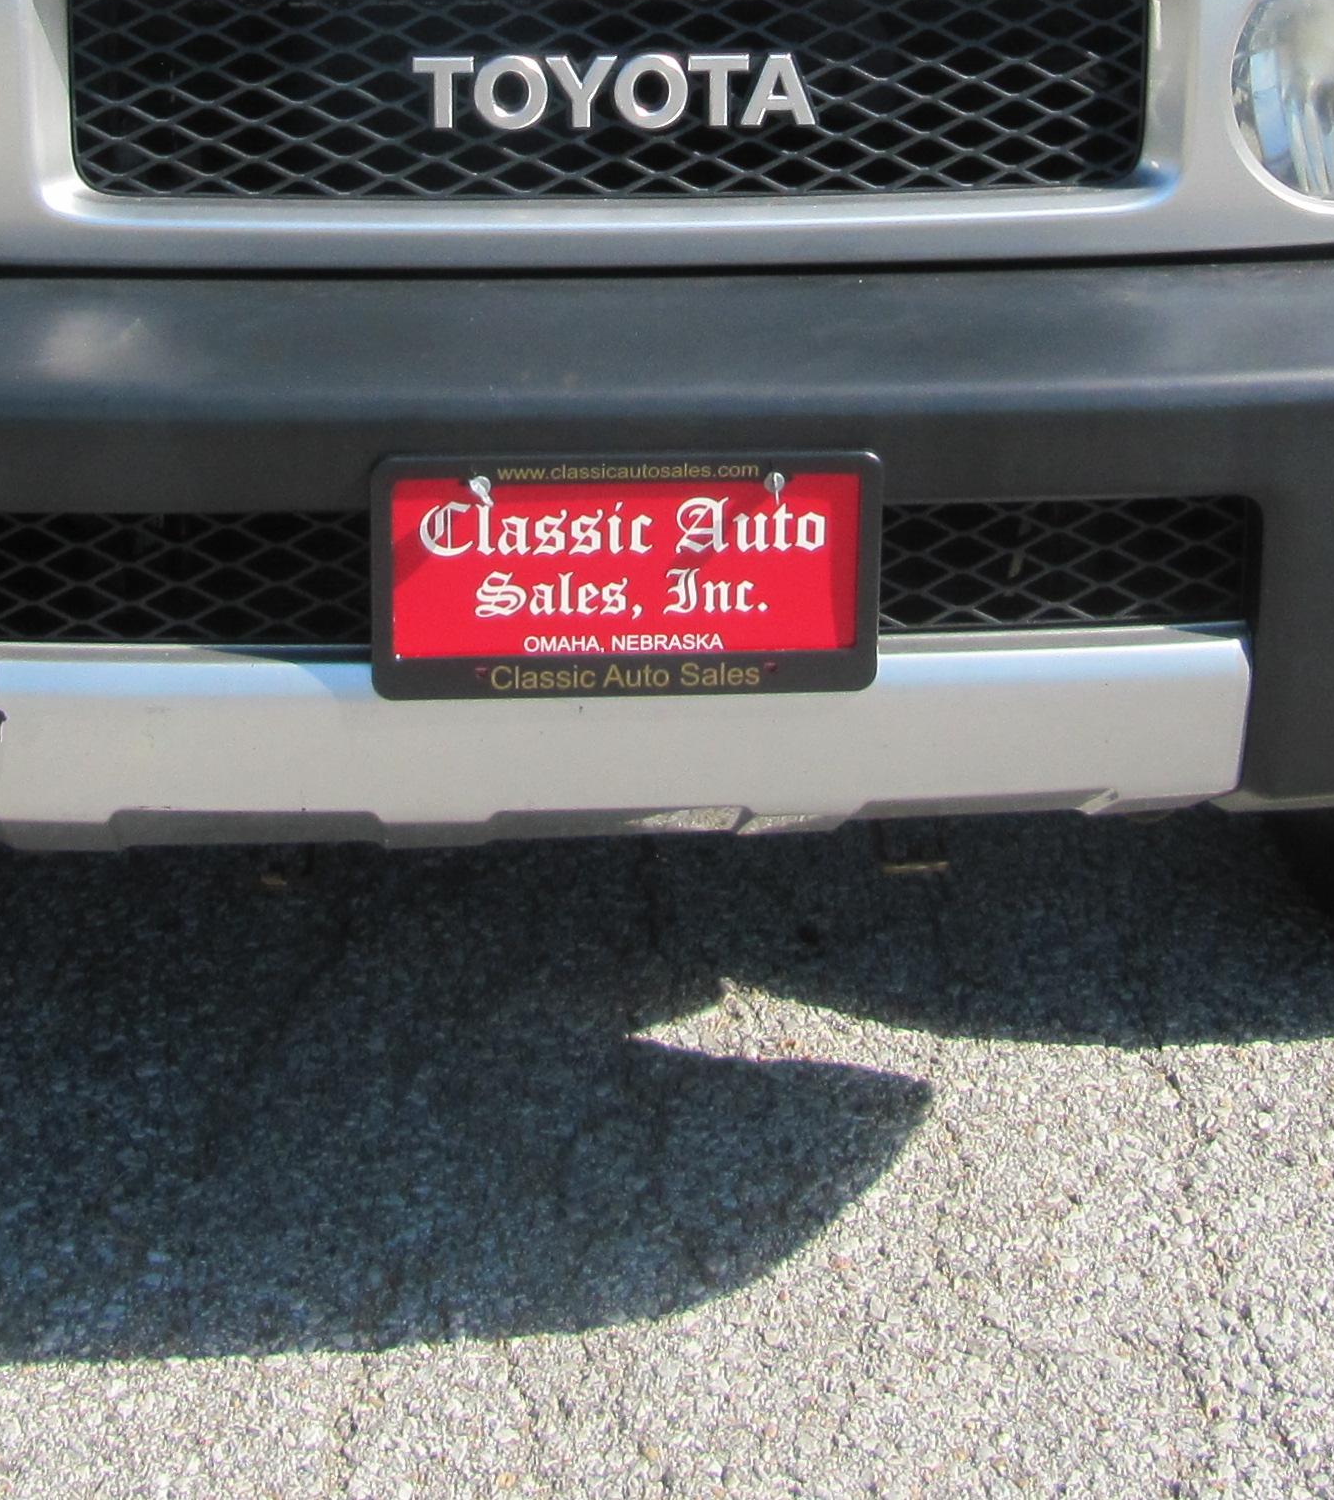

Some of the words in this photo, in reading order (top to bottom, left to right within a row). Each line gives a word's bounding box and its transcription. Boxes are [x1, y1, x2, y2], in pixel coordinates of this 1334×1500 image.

[412, 53, 817, 129] TOYOTA
[497, 463, 760, 480] www.classicautosales.com
[419, 501, 654, 557] Classic
[675, 496, 827, 554] Auto
[475, 571, 644, 620] Sales,
[663, 568, 769, 615] Inc.
[523, 635, 605, 653] OMAHA,
[611, 633, 724, 651] NEBRASKA
[490, 665, 596, 690] Classic
[602, 663, 670, 687] Auto
[679, 662, 760, 686] Sales
